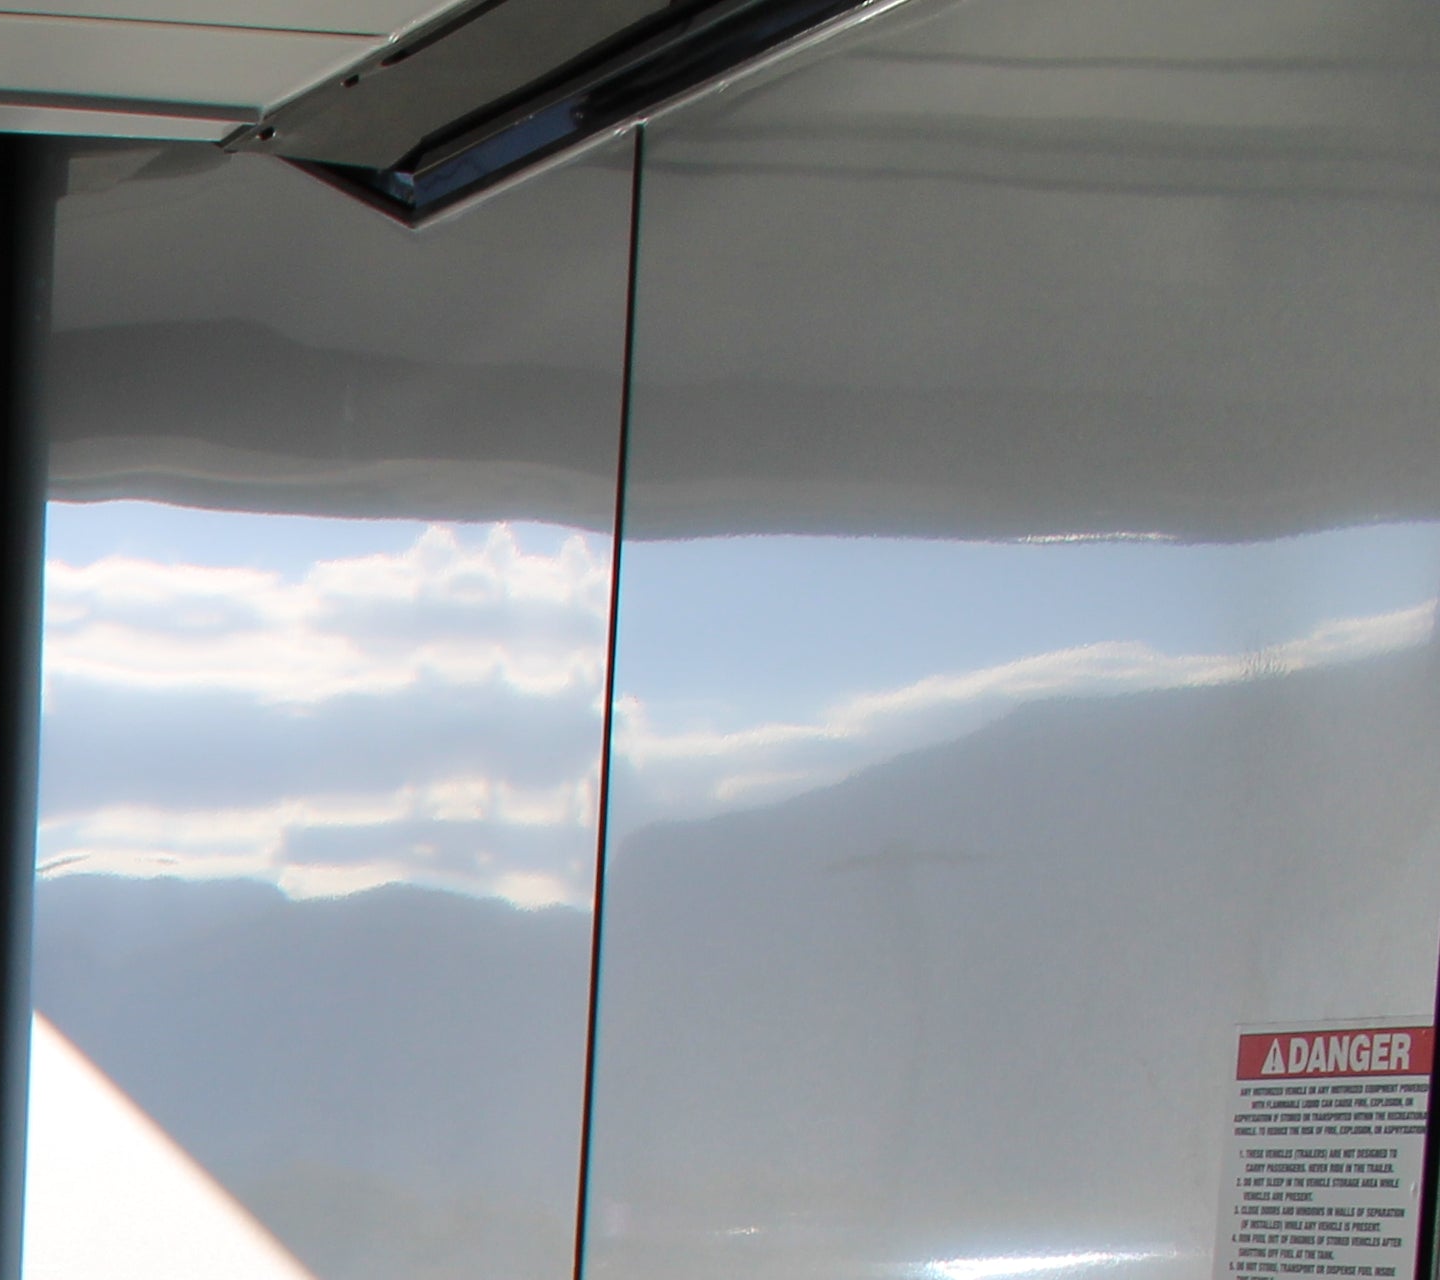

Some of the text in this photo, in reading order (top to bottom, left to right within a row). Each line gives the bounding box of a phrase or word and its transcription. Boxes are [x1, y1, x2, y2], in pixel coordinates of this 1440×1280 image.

[1288, 1033, 1412, 1074] DANGER
[1245, 1149, 1264, 1158] THESE
[1265, 1149, 1293, 1158] VEHICLES
[1329, 1149, 1342, 1158] ARE
[1343, 1149, 1355, 1158] NOT
[1389, 1149, 1398, 1159] TO
[1246, 1163, 1265, 1172] CARRY
[1308, 1164, 1328, 1173] NEVER
[1330, 1164, 1344, 1173] RIDE
[1345, 1164, 1352, 1173] IN
[1354, 1164, 1365, 1173] THE
[1243, 1178, 1400, 1188] DO NOT SLEEP IN THE VEHICLE STORAGE AREA WHILE
[1243, 1192, 1271, 1201] VEHICLES
[1272, 1192, 1284, 1201] ARE
[1240, 1206, 1259, 1215] CLOSE
[1261, 1206, 1281, 1216] DOORS
[1282, 1207, 1294, 1216] AND
[1326, 1207, 1333, 1216] IN
[1335, 1207, 1355, 1217] WALLS
[1357, 1208, 1365, 1217] OF
[1366, 1208, 1406, 1218] SEPARATION
[1284, 1221, 1303, 1230] WHILE
[1304, 1221, 1317, 1231] ANY
[1318, 1222, 1343, 1231] VEHICLE
[1344, 1222, 1351, 1231] IS
[1252, 1234, 1266, 1244] FUEL
[1281, 1235, 1288, 1244] OF
[1317, 1236, 1325, 1245] OF
[1351, 1237, 1381, 1247] VEHICLES
[1382, 1238, 1403, 1247] AFTER
[1280, 1249, 1294, 1259] FUEL
[1296, 1250, 1303, 1259] AT
[1304, 1250, 1316, 1259] THE
[1236, 1262, 1244, 1271] DO
[1246, 1262, 1257, 1272] NOT
[1280, 1264, 1315, 1274] TRANSPORT
[1316, 1265, 1325, 1274] OR
[1358, 1266, 1373, 1276] FUEL
